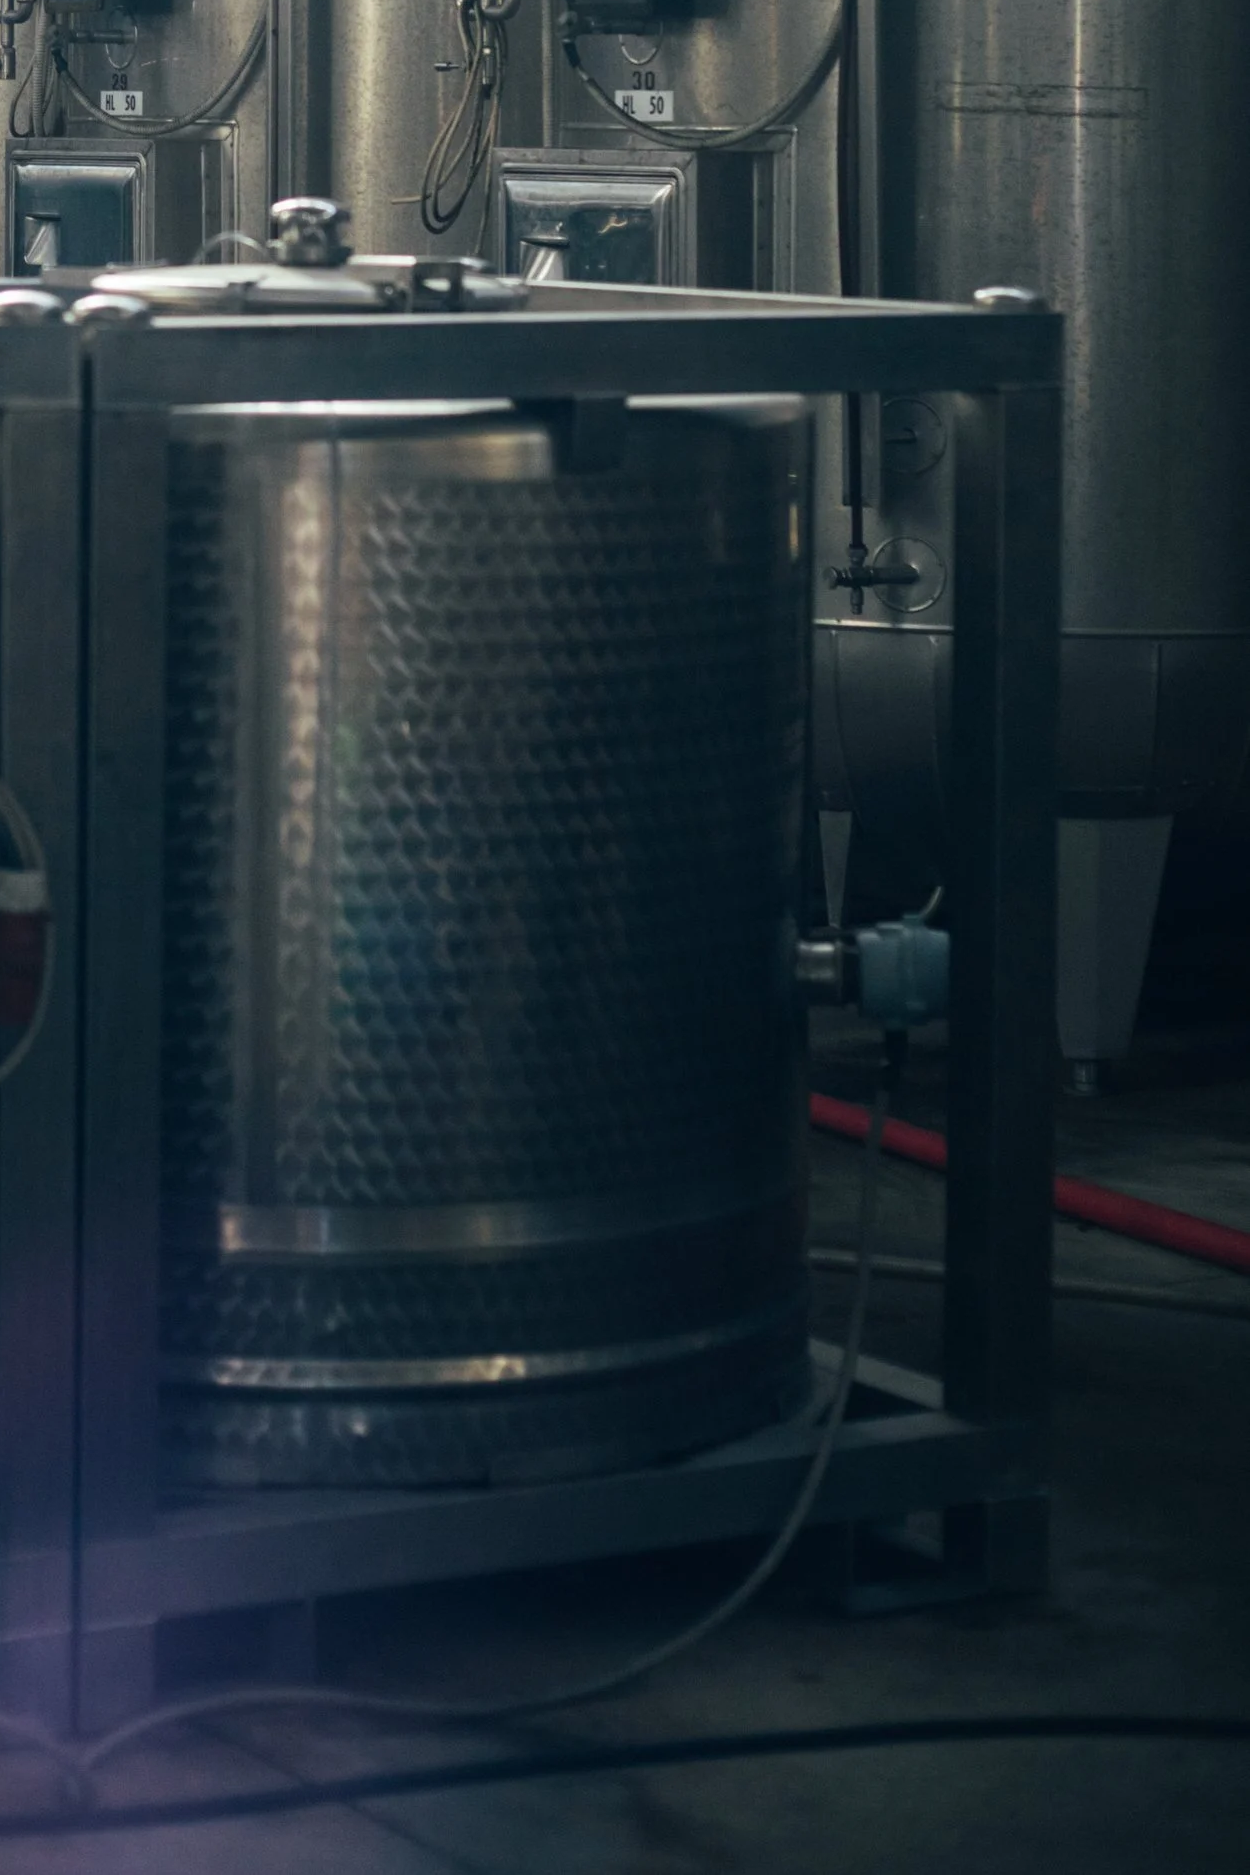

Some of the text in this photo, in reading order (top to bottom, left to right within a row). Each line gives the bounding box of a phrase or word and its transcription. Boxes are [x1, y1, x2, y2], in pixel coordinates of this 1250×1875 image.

[112, 73, 127, 90] 29
[633, 71, 655, 90] 30
[105, 94, 136, 111] HL 50
[622, 95, 664, 115] HL 50
